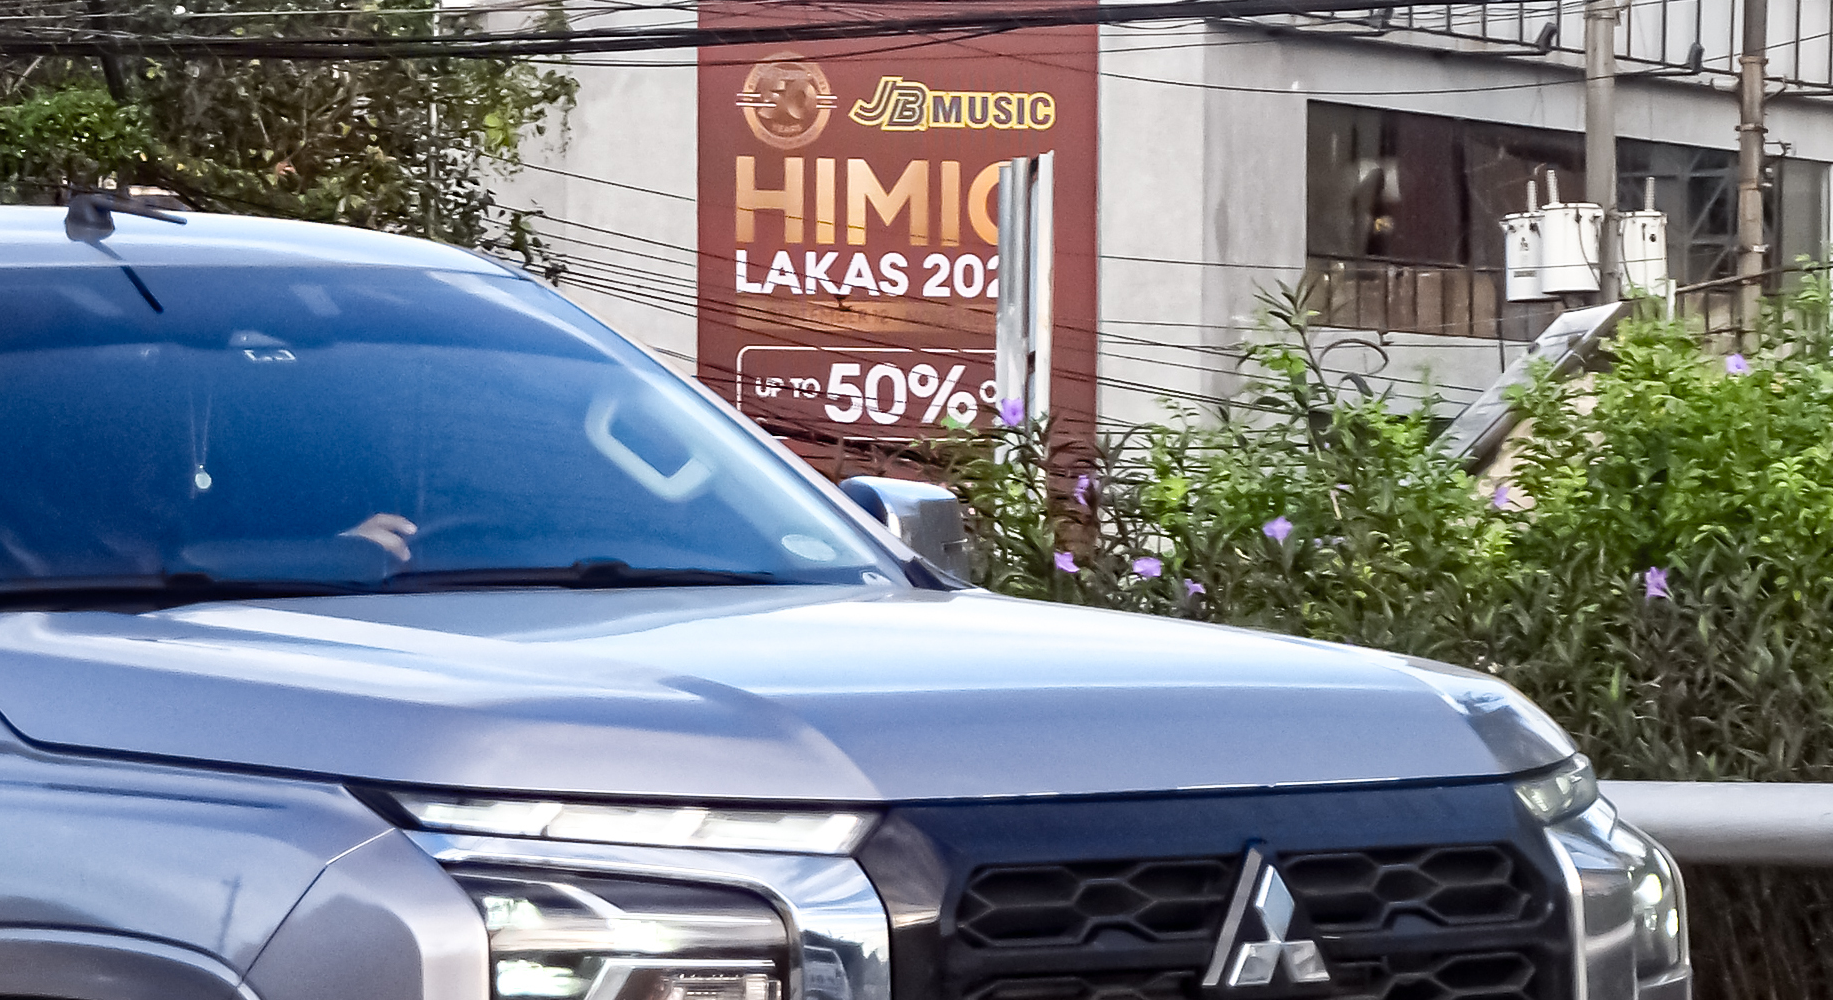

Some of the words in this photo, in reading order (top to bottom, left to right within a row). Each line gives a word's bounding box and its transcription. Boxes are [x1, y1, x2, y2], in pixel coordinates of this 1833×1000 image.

[849, 76, 930, 131] JB
[930, 92, 1056, 130] MUSIC
[735, 250, 909, 296] LAKAS
[755, 377, 785, 398] UP
[789, 377, 821, 398] TO
[824, 362, 978, 424] 50%
